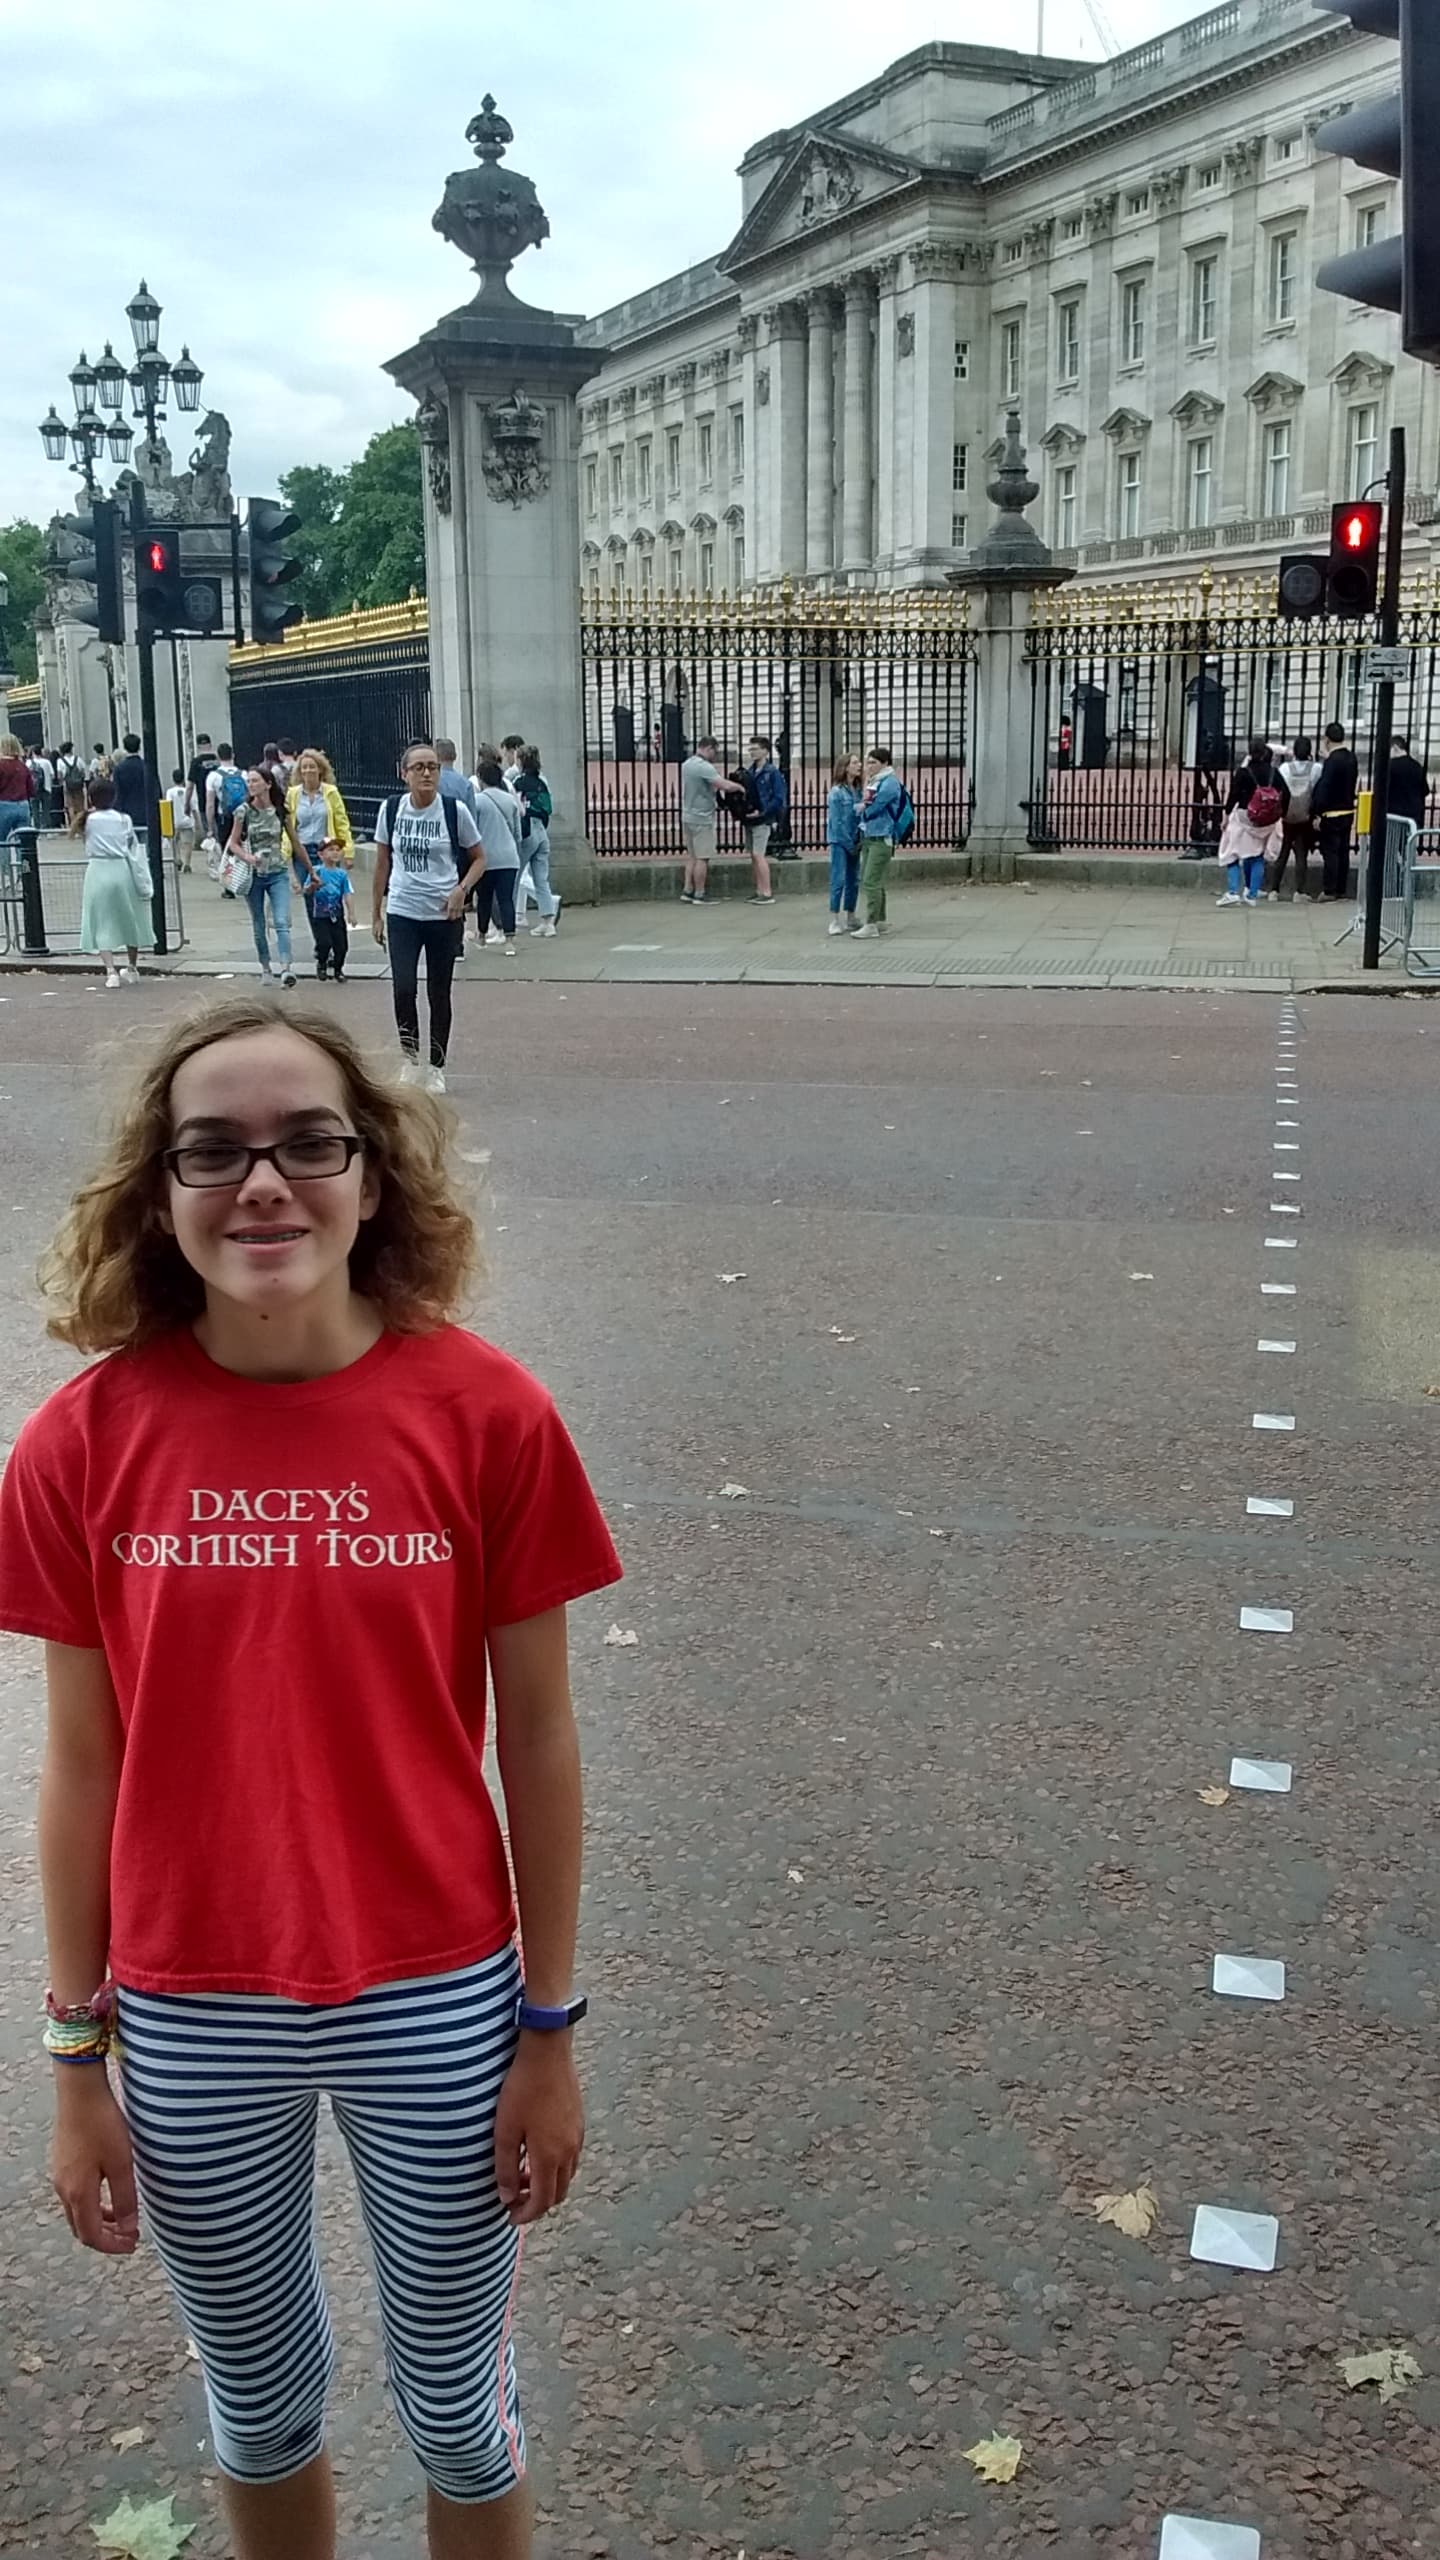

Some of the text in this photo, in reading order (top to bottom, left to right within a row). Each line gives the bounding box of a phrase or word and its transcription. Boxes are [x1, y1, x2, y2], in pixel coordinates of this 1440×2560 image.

[416, 820, 441, 838] YORK
[400, 836, 430, 855] PARIS
[188, 1481, 370, 1522] DACEY'S
[112, 1528, 453, 1567] CORNISH TOURS
